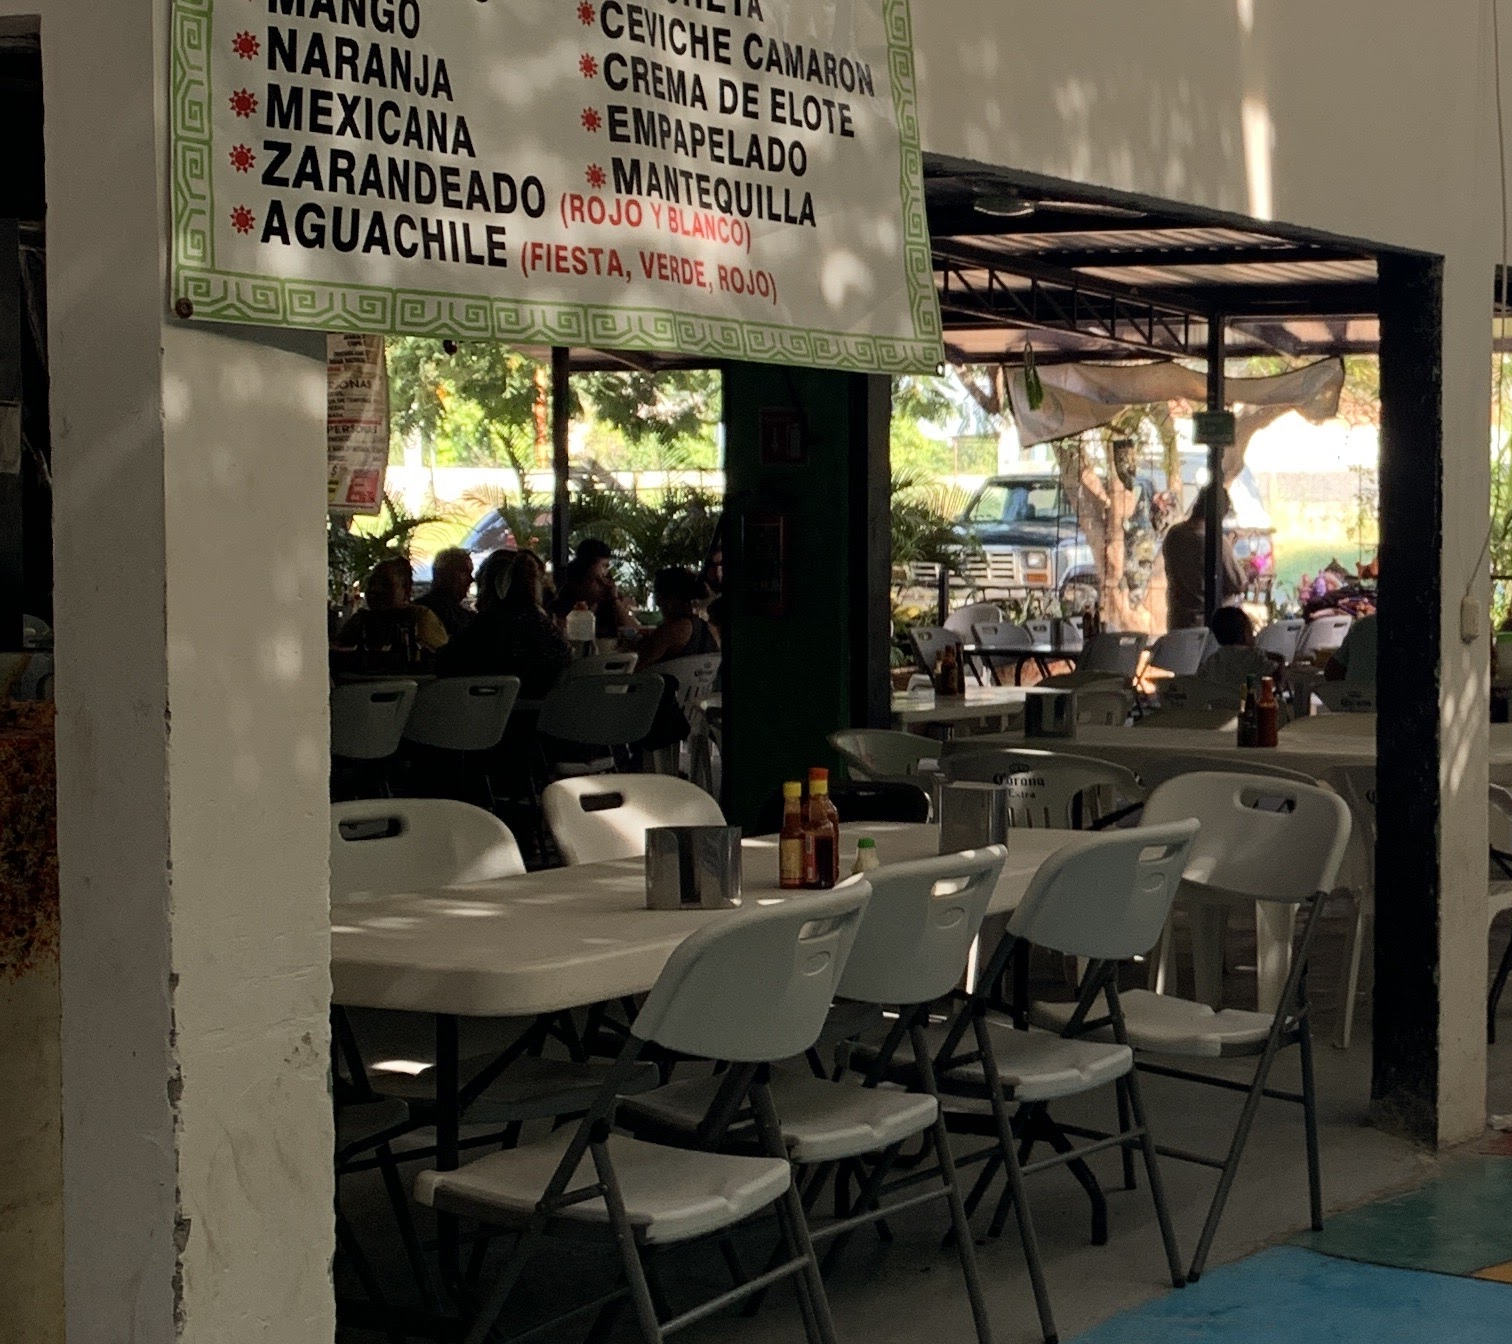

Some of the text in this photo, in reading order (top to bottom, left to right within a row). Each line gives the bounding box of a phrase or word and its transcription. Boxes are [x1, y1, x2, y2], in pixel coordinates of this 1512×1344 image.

[267, 25, 454, 102] NARANJA
[600, 0, 875, 97] CEVICHE CAMARON
[265, 83, 476, 158] MEXICANA
[604, 52, 855, 138] CREMA DE ELOTE
[607, 105, 807, 177] EMPAPELADO
[261, 140, 751, 254] ZARANDEADO (ROJO Y BLANCO)
[611, 157, 816, 228] MANTEQUILLA
[261, 199, 777, 305] AGUACHILE (FIESTA, VERDE, ROJO)
